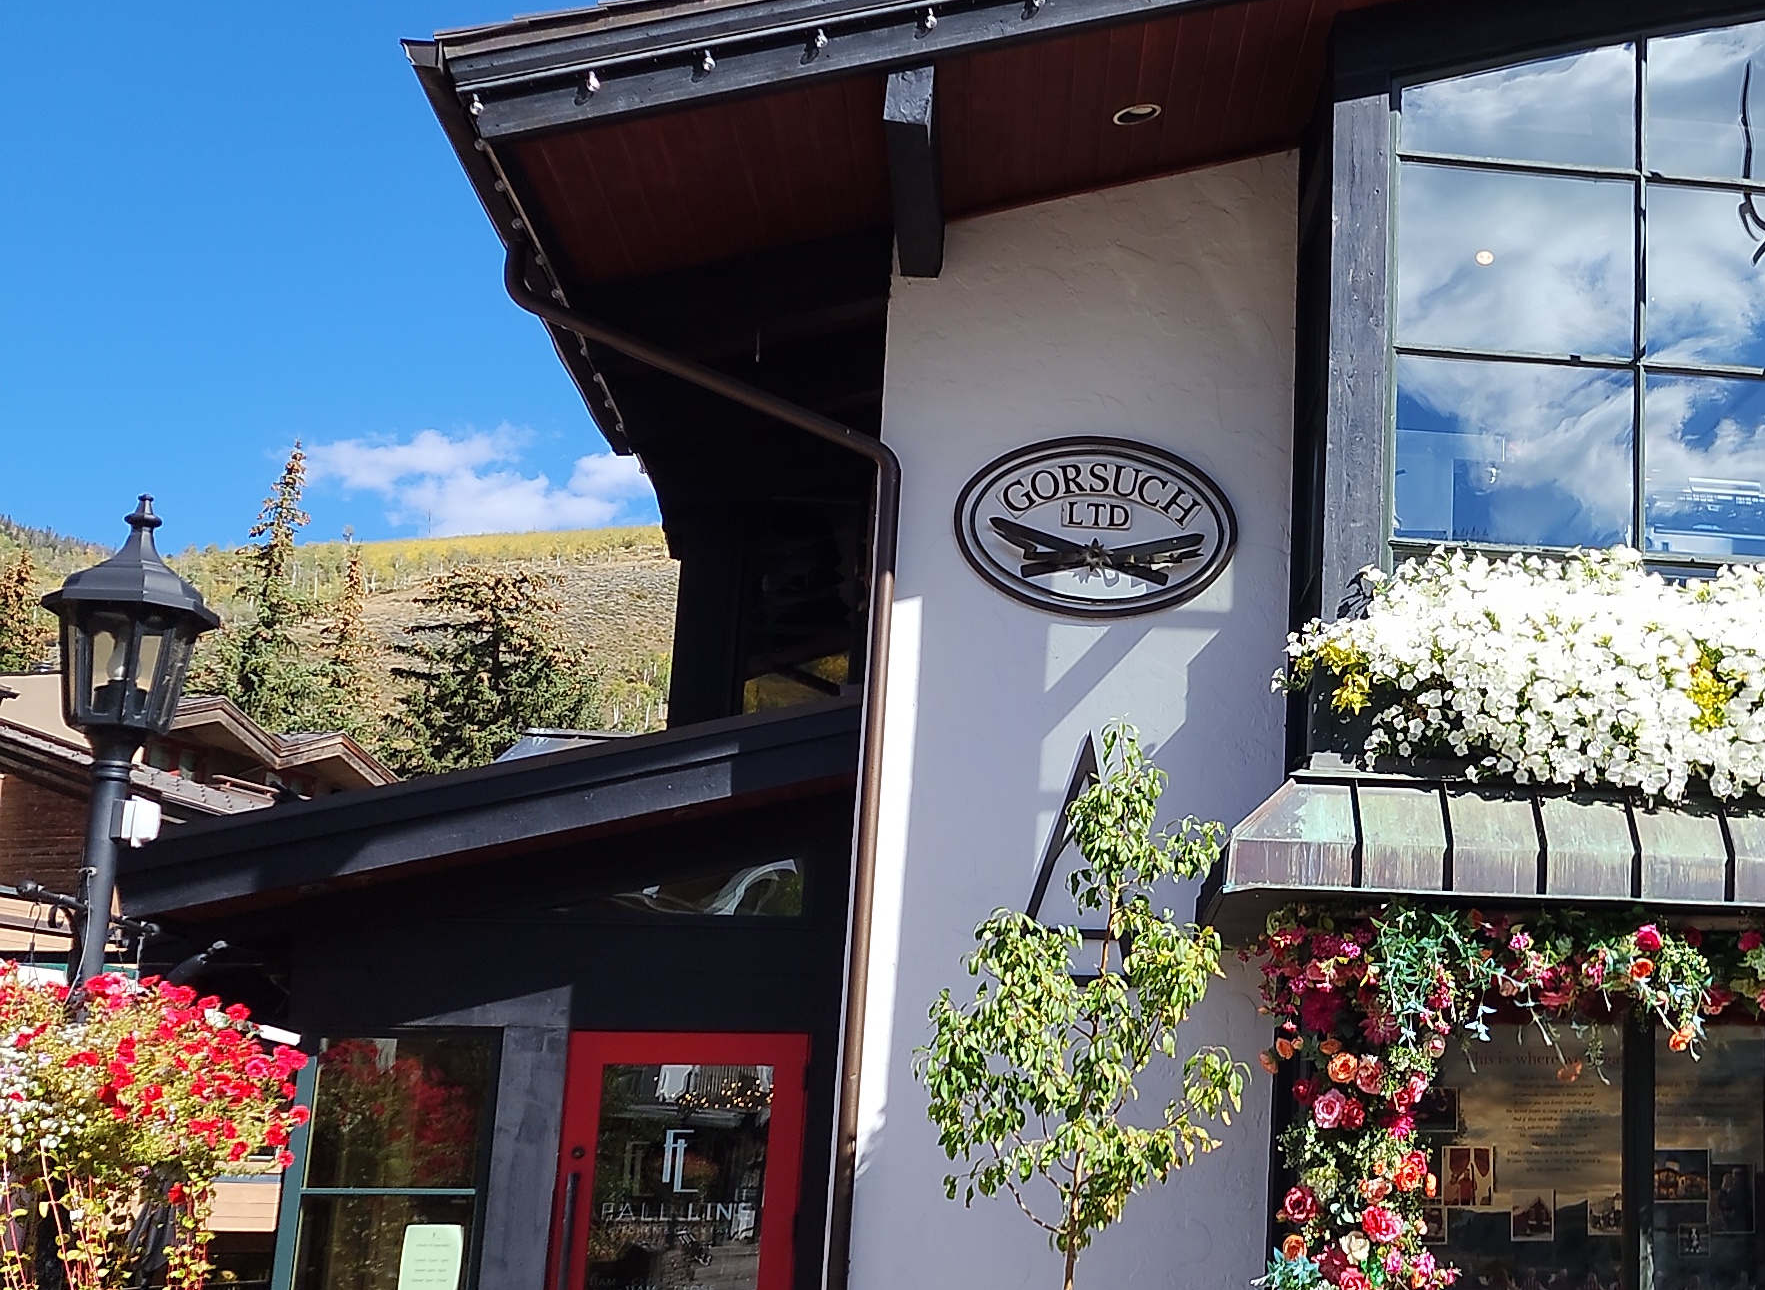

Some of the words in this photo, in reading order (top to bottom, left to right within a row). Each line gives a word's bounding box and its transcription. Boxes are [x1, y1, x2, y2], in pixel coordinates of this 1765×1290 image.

[1002, 463, 1202, 527] GORSUCH
[1067, 501, 1130, 527] LTD
[1516, 1051, 1559, 1065] where
[601, 1202, 672, 1221] FALL
[687, 1202, 753, 1221] LINE
